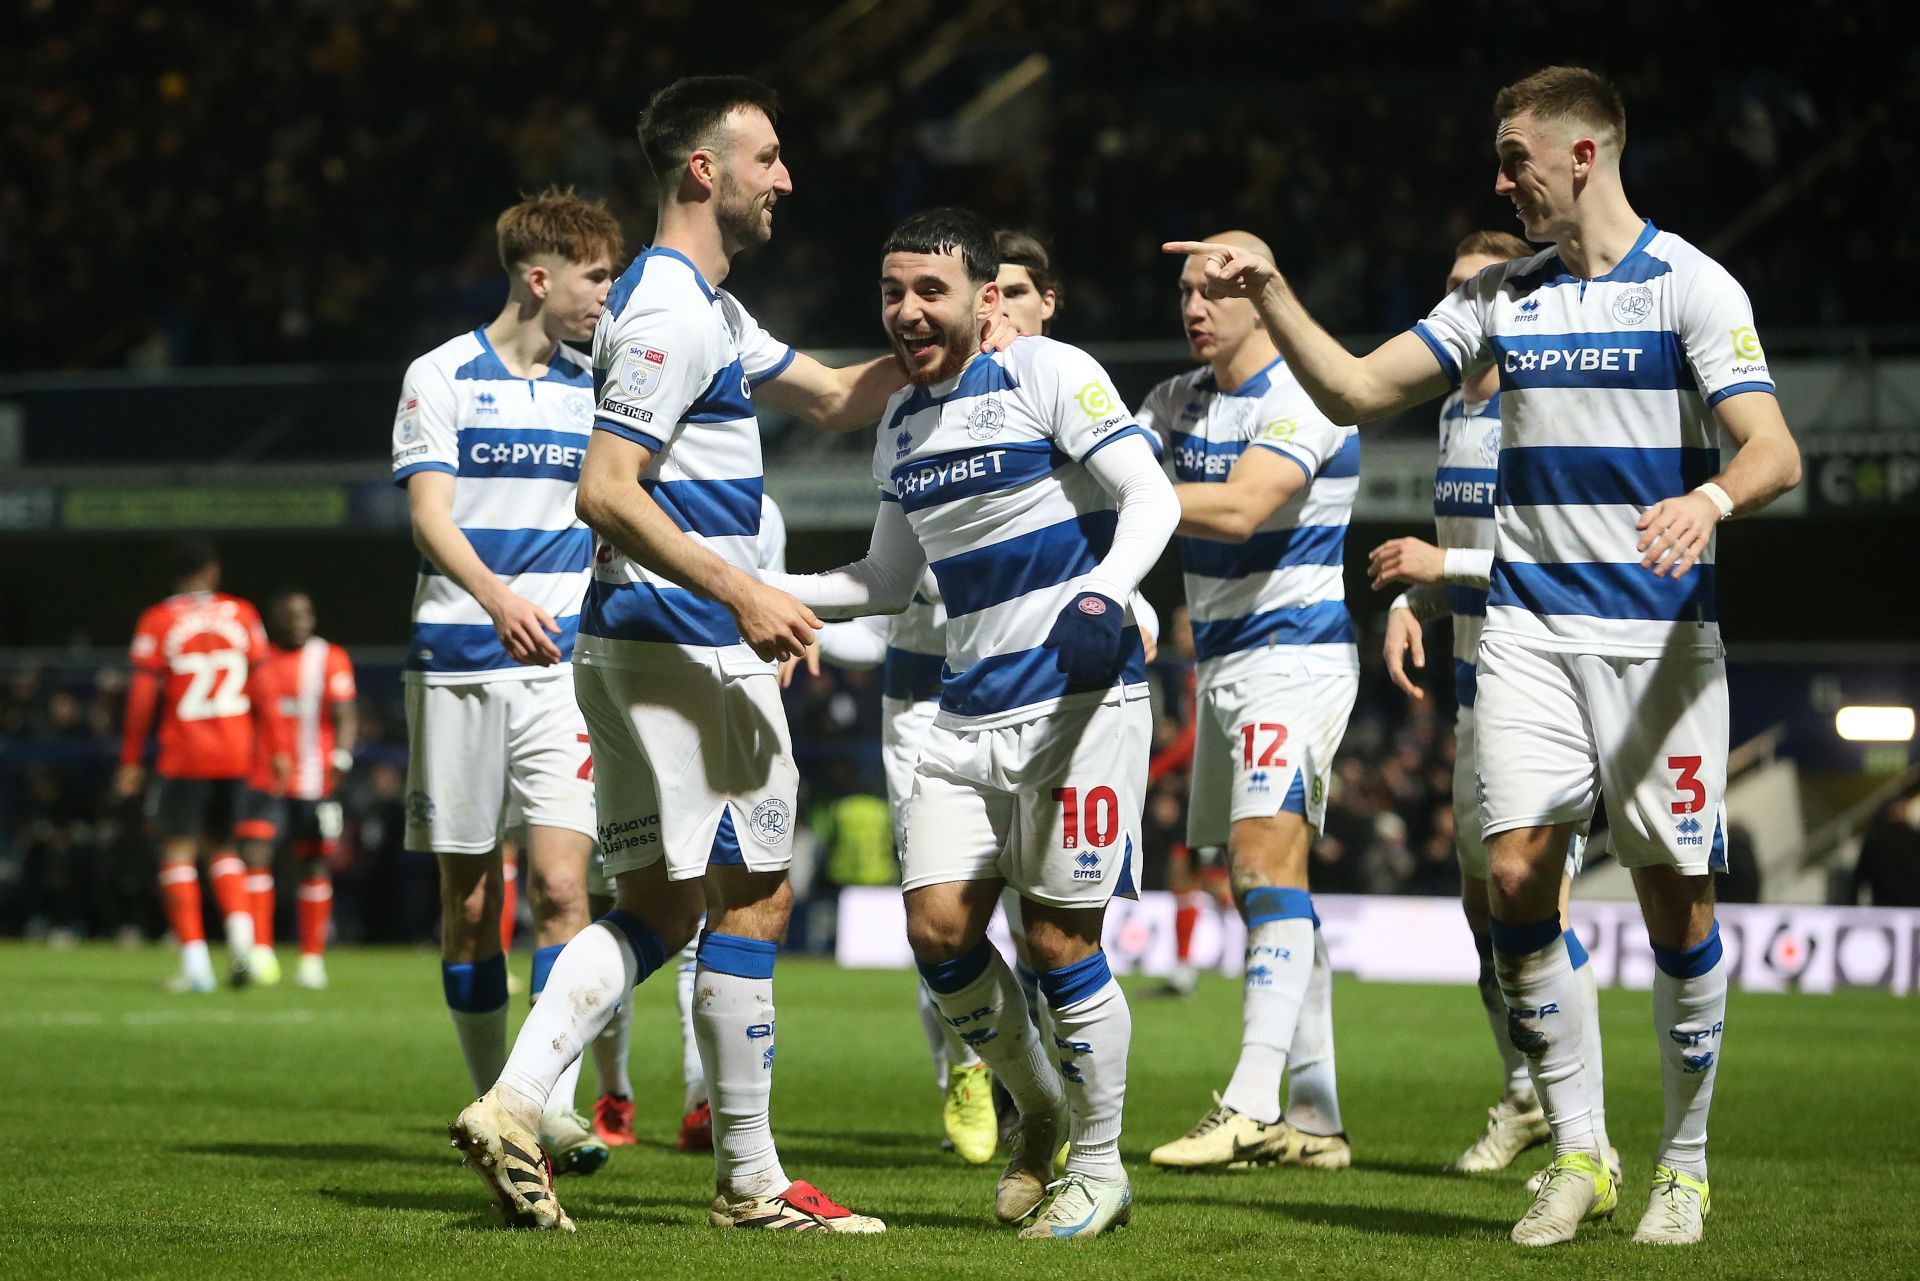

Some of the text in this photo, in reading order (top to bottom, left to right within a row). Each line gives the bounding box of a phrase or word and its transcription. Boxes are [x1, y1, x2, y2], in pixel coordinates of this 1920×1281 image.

[1514, 313, 1539, 323] errea
[630, 347, 664, 363] sky bet
[629, 384, 642, 394] EFL
[169, 649, 251, 722] 22
[1241, 723, 1288, 771] 12
[1668, 756, 1706, 814] 3
[1051, 786, 1119, 849] 10
[1676, 836, 1703, 845] errea
[1073, 869, 1102, 879] errea
